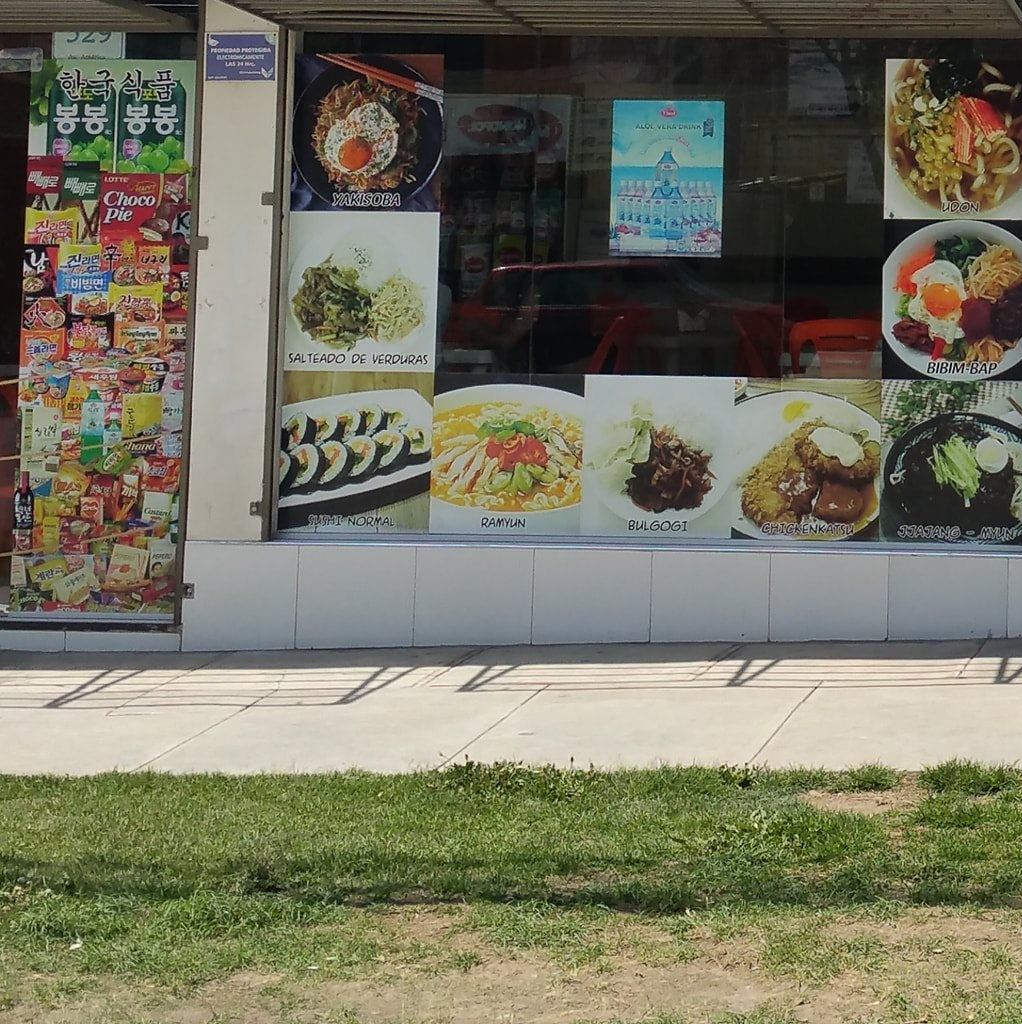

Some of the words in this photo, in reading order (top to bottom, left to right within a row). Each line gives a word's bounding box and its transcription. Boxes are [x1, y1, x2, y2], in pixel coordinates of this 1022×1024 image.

[59, 68, 115, 101] 한국
[121, 68, 177, 102] 식품
[53, 103, 109, 135] 봉봉
[123, 103, 179, 135] 봉봉
[103, 190, 156, 207] Choco
[332, 192, 401, 207] YAKISOBA
[941, 201, 979, 213] UDON
[288, 352, 347, 365] SALTEADO
[351, 353, 369, 365] DE
[372, 353, 429, 366] VERDURAS
[926, 361, 999, 375] BIBIM-BAP
[307, 515, 343, 527] SUSHI
[347, 516, 395, 528] NORMAL
[481, 517, 527, 529] RAMYUN
[628, 520, 688, 532] BULGOGI
[761, 522, 855, 536] CHICKENKATSU
[897, 525, 962, 539] JJAJANG
[978, 525, 1016, 540] MYUN
